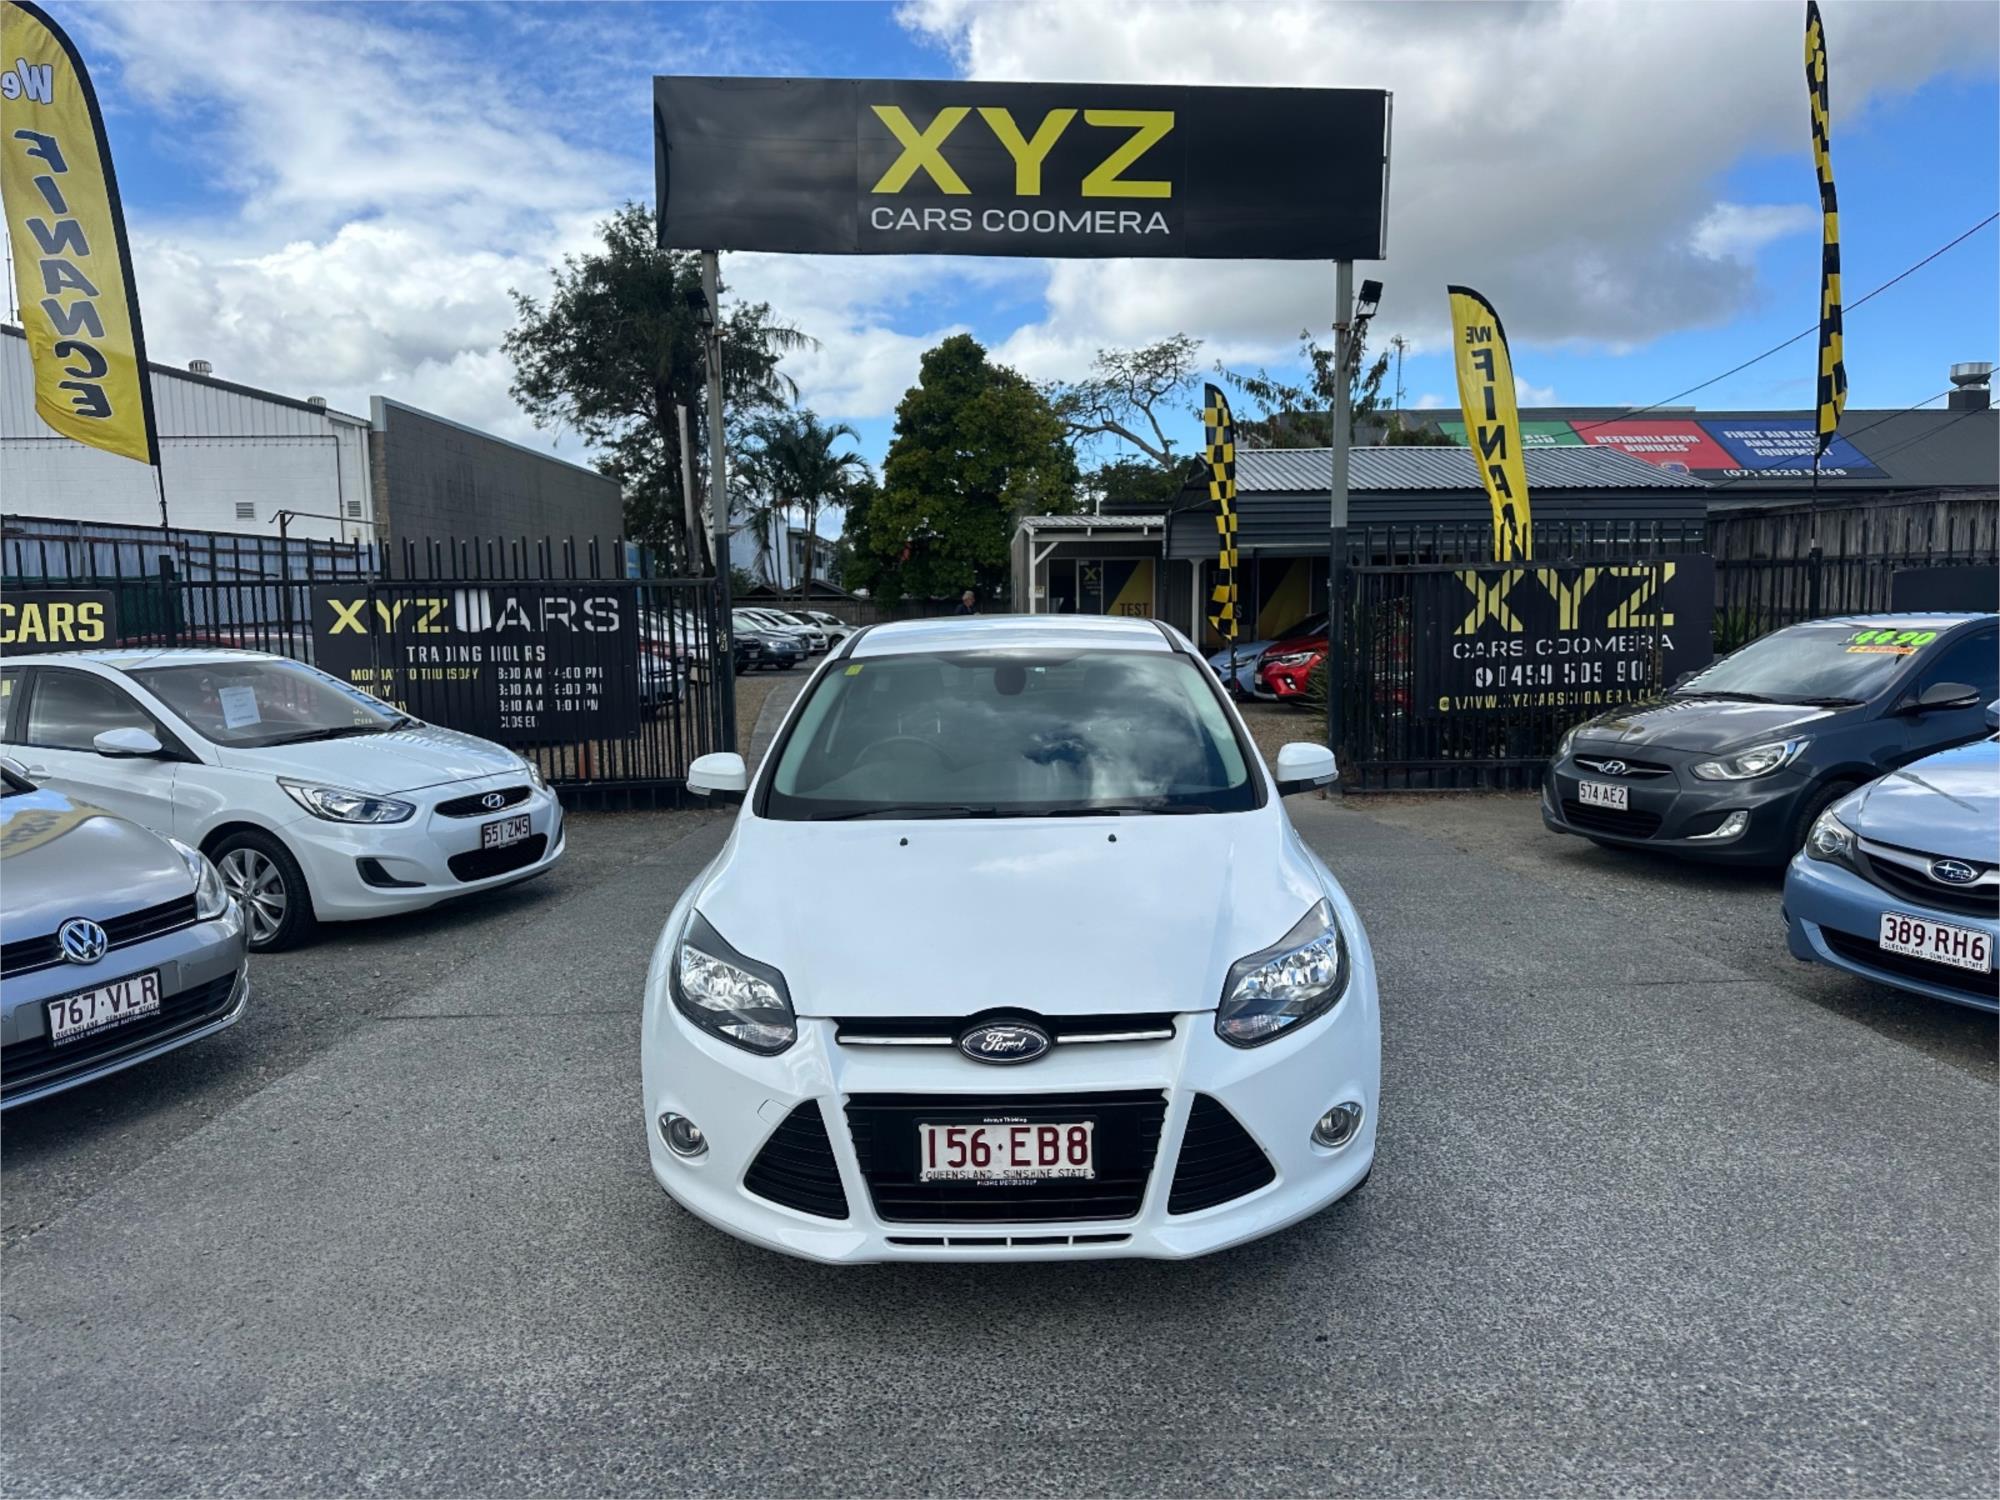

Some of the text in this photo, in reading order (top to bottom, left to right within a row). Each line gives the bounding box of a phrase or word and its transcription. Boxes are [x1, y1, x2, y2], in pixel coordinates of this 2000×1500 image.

[870, 104, 1176, 199] XYZ
[870, 207, 1170, 236] CARS COOMERA
[1595, 435, 1700, 444] DEFIBRILLATOR
[1723, 430, 1764, 439] FIRST
[1454, 562, 1675, 634] XYZ
[327, 598, 449, 634] XYZ
[1119, 602, 1149, 616] TEST
[980, 1031, 1027, 1052] Ford
[925, 1170, 993, 1180] QUEENSLAND
